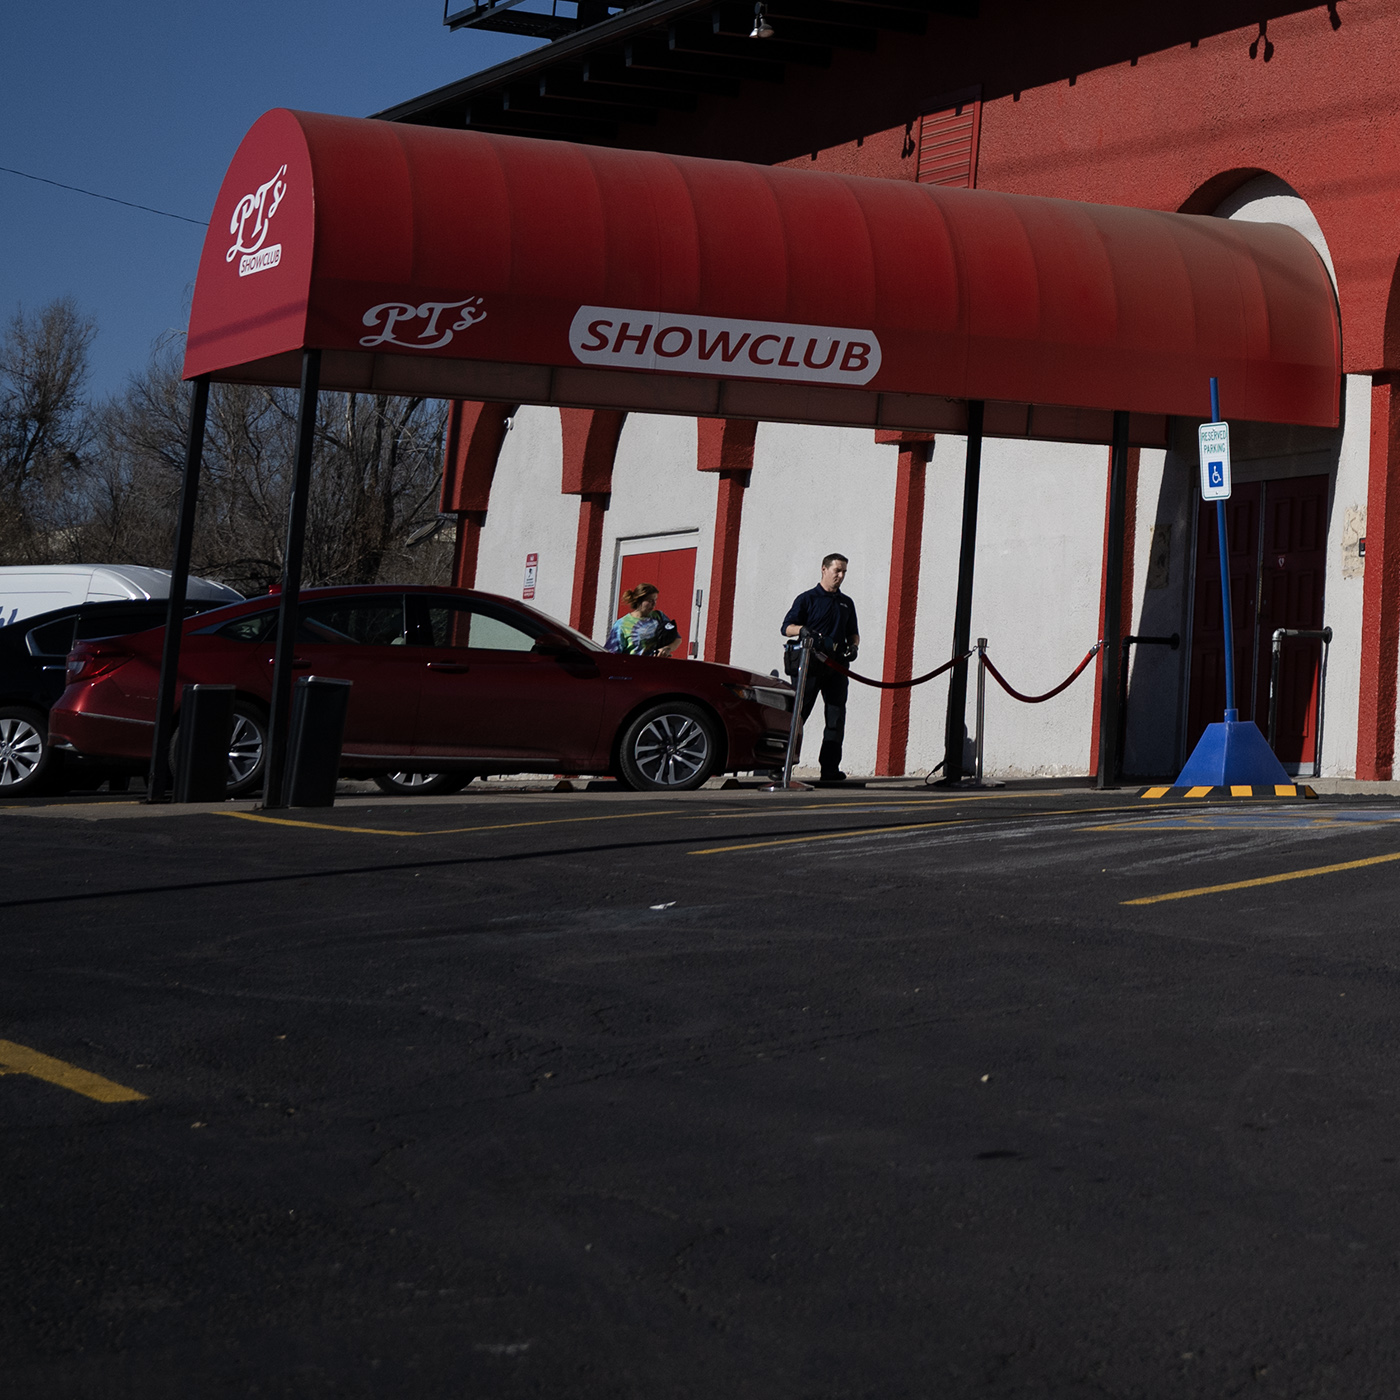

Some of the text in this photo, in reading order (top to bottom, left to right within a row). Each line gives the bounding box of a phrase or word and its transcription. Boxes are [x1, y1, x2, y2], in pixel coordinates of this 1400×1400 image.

[241, 249, 280, 274] SHOWCLUB
[580, 319, 873, 372] SHOWCLUB
[1201, 430, 1227, 442] RESERVED
[1203, 443, 1226, 454] PARKING
